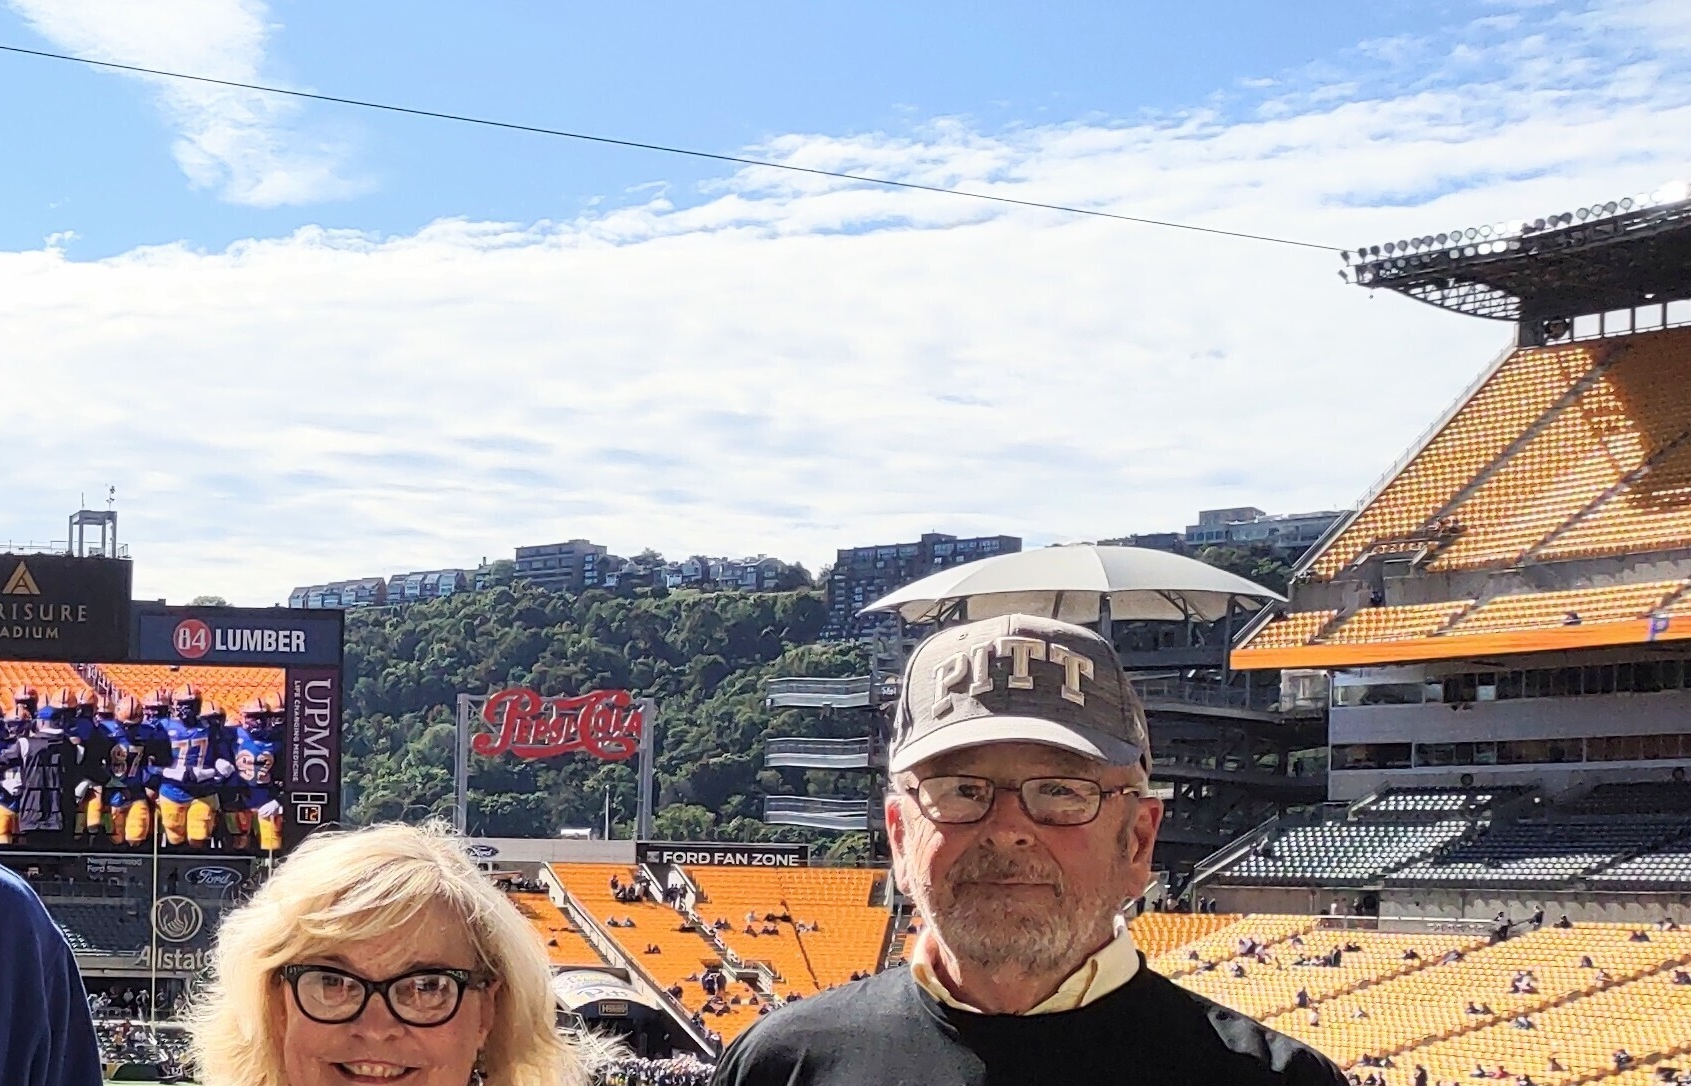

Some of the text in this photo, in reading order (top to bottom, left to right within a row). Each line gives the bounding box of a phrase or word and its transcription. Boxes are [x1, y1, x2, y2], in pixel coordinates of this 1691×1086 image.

[177, 628, 307, 654] 84 LUMBER
[930, 636, 1095, 720] PITT
[303, 678, 331, 784] UPMC
[662, 851, 800, 867] FORD FAN ZONE
